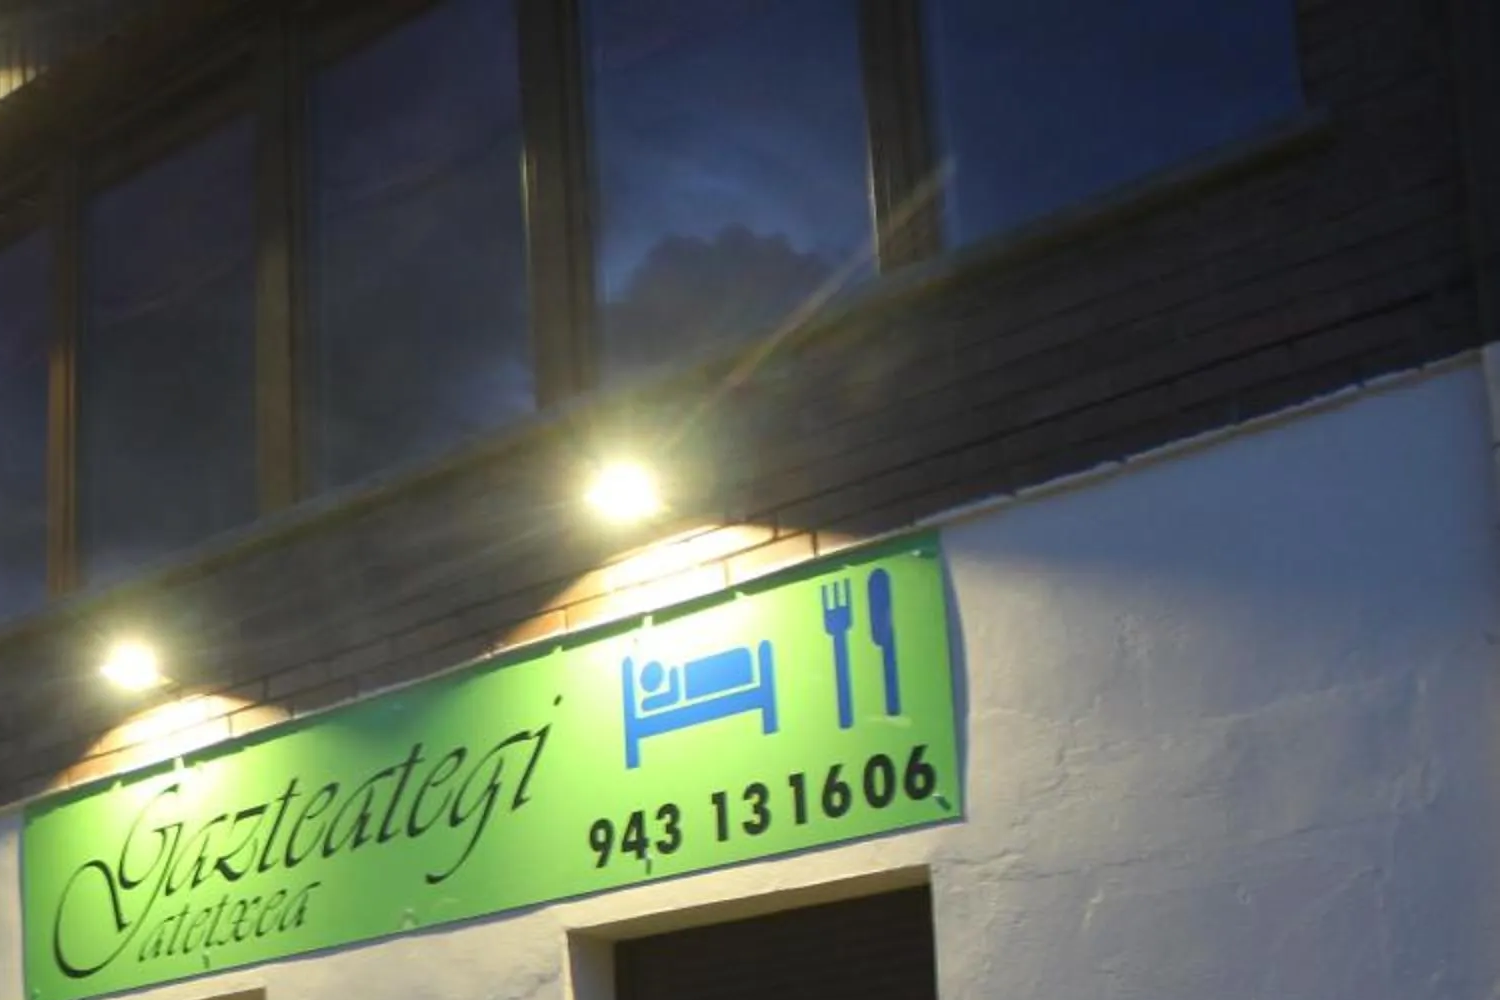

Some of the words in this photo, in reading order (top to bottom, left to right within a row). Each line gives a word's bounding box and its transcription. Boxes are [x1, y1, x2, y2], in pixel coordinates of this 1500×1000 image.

[118, 694, 563, 897] Gazteategi
[588, 802, 682, 869] 943
[710, 743, 937, 842] 131606
